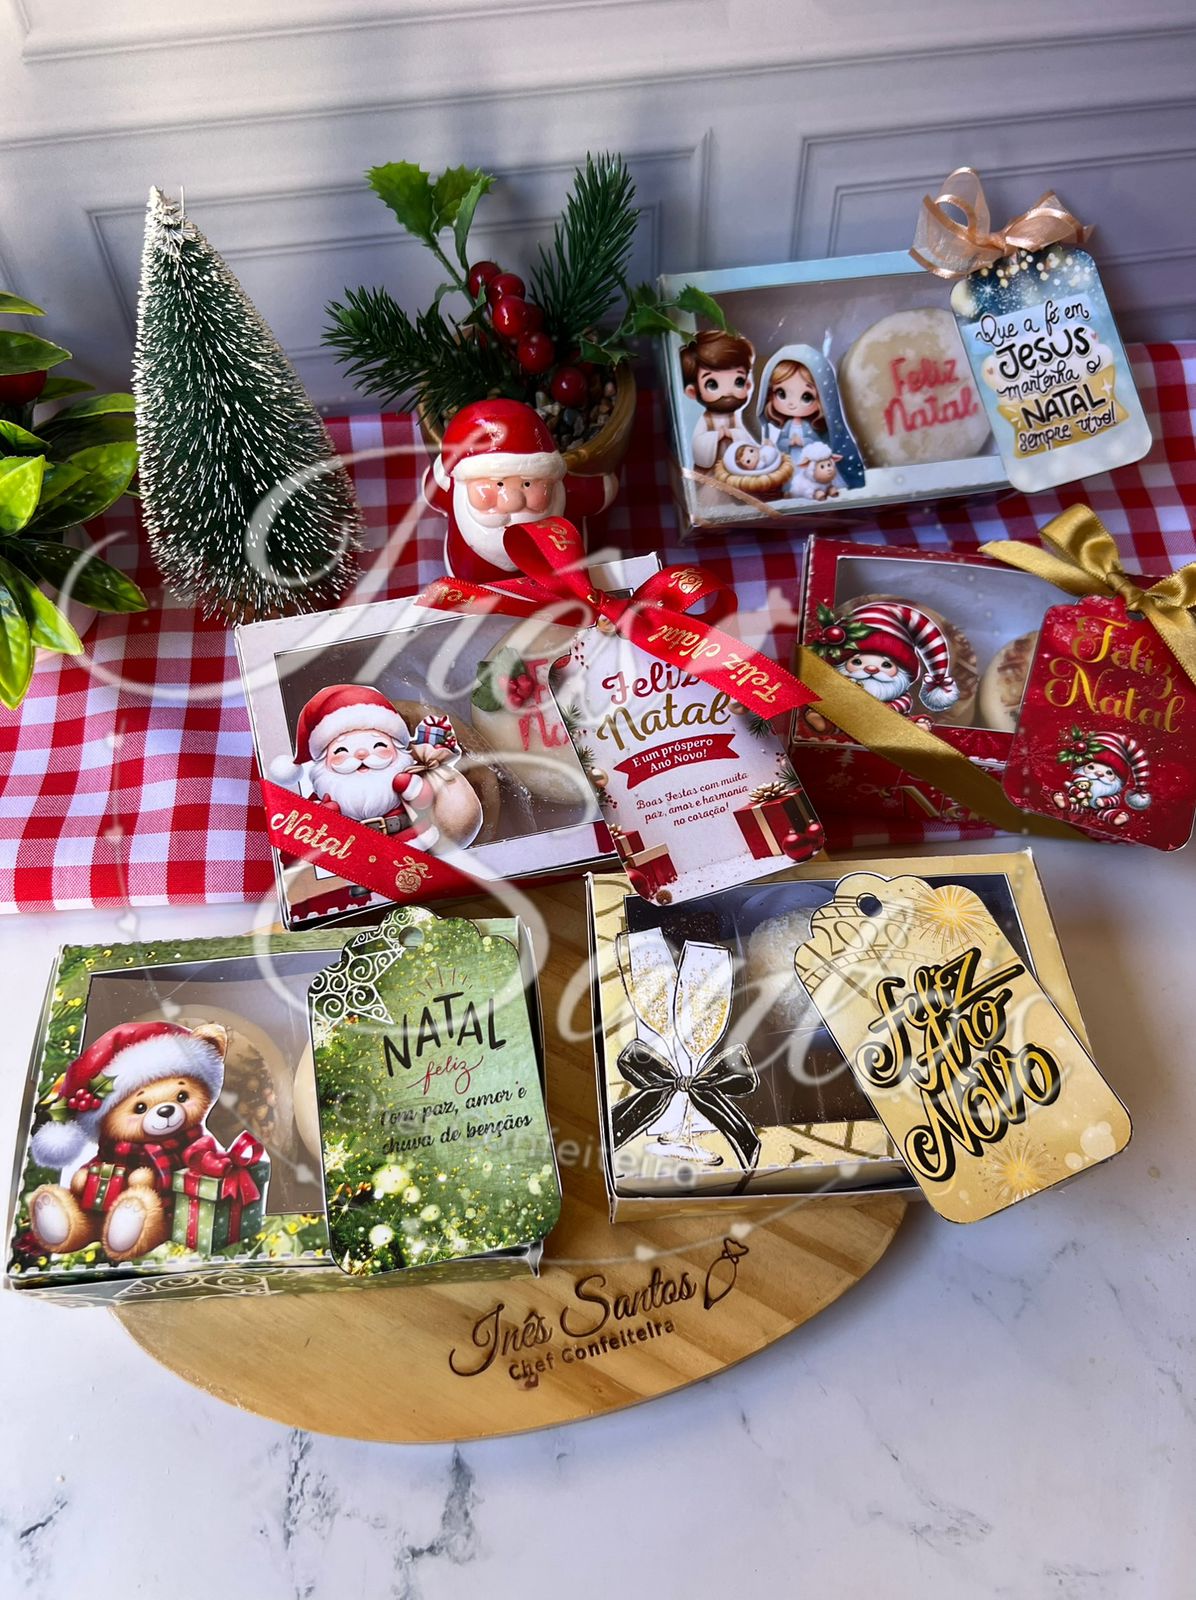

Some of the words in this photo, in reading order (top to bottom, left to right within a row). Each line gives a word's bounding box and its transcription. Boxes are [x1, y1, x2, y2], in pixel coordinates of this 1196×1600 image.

[975, 314, 1018, 347] Que
[1024, 318, 1040, 332] a
[1064, 300, 1089, 320] em
[889, 357, 961, 397] Feliz
[996, 361, 1080, 398] mantenha
[1087, 354, 1101, 374] o
[884, 385, 979, 438] Natal
[1018, 422, 1072, 454] sempre
[1076, 401, 1117, 435] vivo!
[1021, 384, 1107, 429] NATAL
[648, 624, 722, 661] Natal
[1071, 615, 1179, 700] Feliz
[602, 661, 702, 705] Feliz
[721, 653, 782, 703] Feliz
[1044, 656, 1187, 735] Natal
[597, 693, 731, 751] Natal
[632, 756, 642, 768] E
[642, 749, 661, 763] um
[662, 737, 713, 758] próspero
[650, 758, 672, 773] Ano
[673, 749, 707, 764] Novo!
[636, 796, 663, 810] Boas
[665, 786, 699, 802] Festas
[700, 781, 720, 793] com
[721, 771, 748, 786] muita
[644, 810, 668, 825] paz,
[669, 803, 693, 815] amor
[695, 799, 702, 807] e
[702, 785, 749, 804] harmonia
[272, 810, 356, 862] Natal
[673, 817, 686, 827] no
[688, 804, 731, 823] coração!
[383, 991, 507, 1078] NATAL
[406, 1055, 484, 1095] feliz
[422, 1099, 459, 1124] paz,
[465, 1089, 512, 1111] amor
[439, 1128, 461, 1144] de
[449, 1303, 553, 1377] Inês
[559, 1267, 698, 1338] Santos
[509, 1354, 554, 1381] Chef
[563, 1320, 675, 1363] Confeiteira
